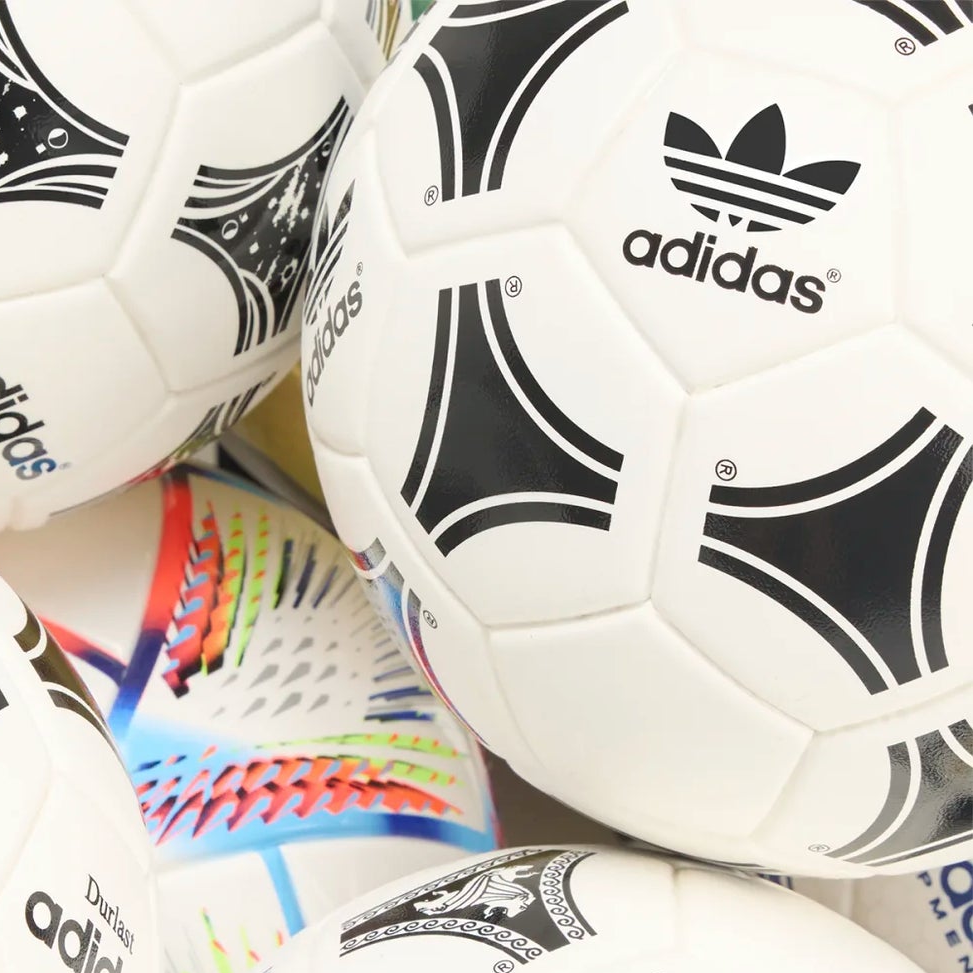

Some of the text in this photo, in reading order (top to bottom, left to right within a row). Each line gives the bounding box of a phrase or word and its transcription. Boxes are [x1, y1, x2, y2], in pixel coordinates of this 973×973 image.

[622, 229, 826, 314] adidas
[306, 280, 363, 408] adidas
[84, 874, 136, 955] Durlast
